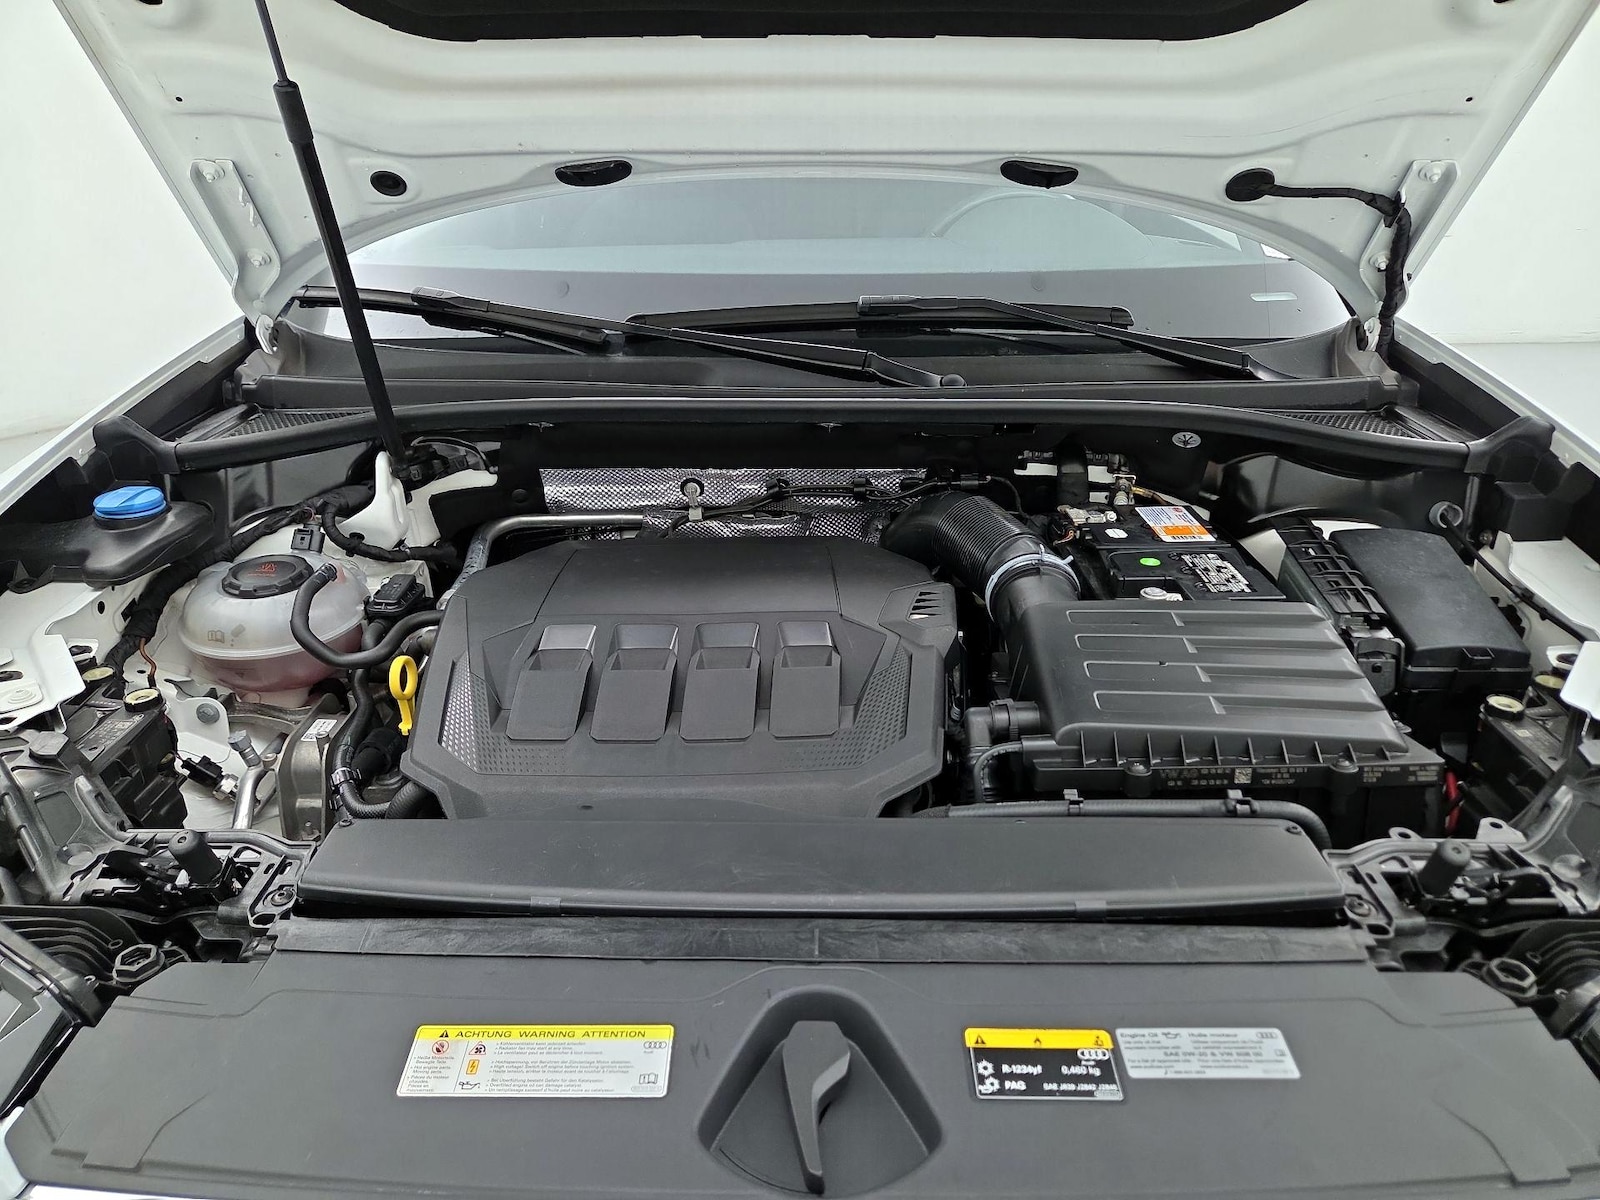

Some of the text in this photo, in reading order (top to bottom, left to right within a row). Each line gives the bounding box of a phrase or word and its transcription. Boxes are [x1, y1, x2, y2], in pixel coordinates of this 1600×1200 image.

[455, 1030, 646, 1038] ACHTUNG WARNING ATTENTION
